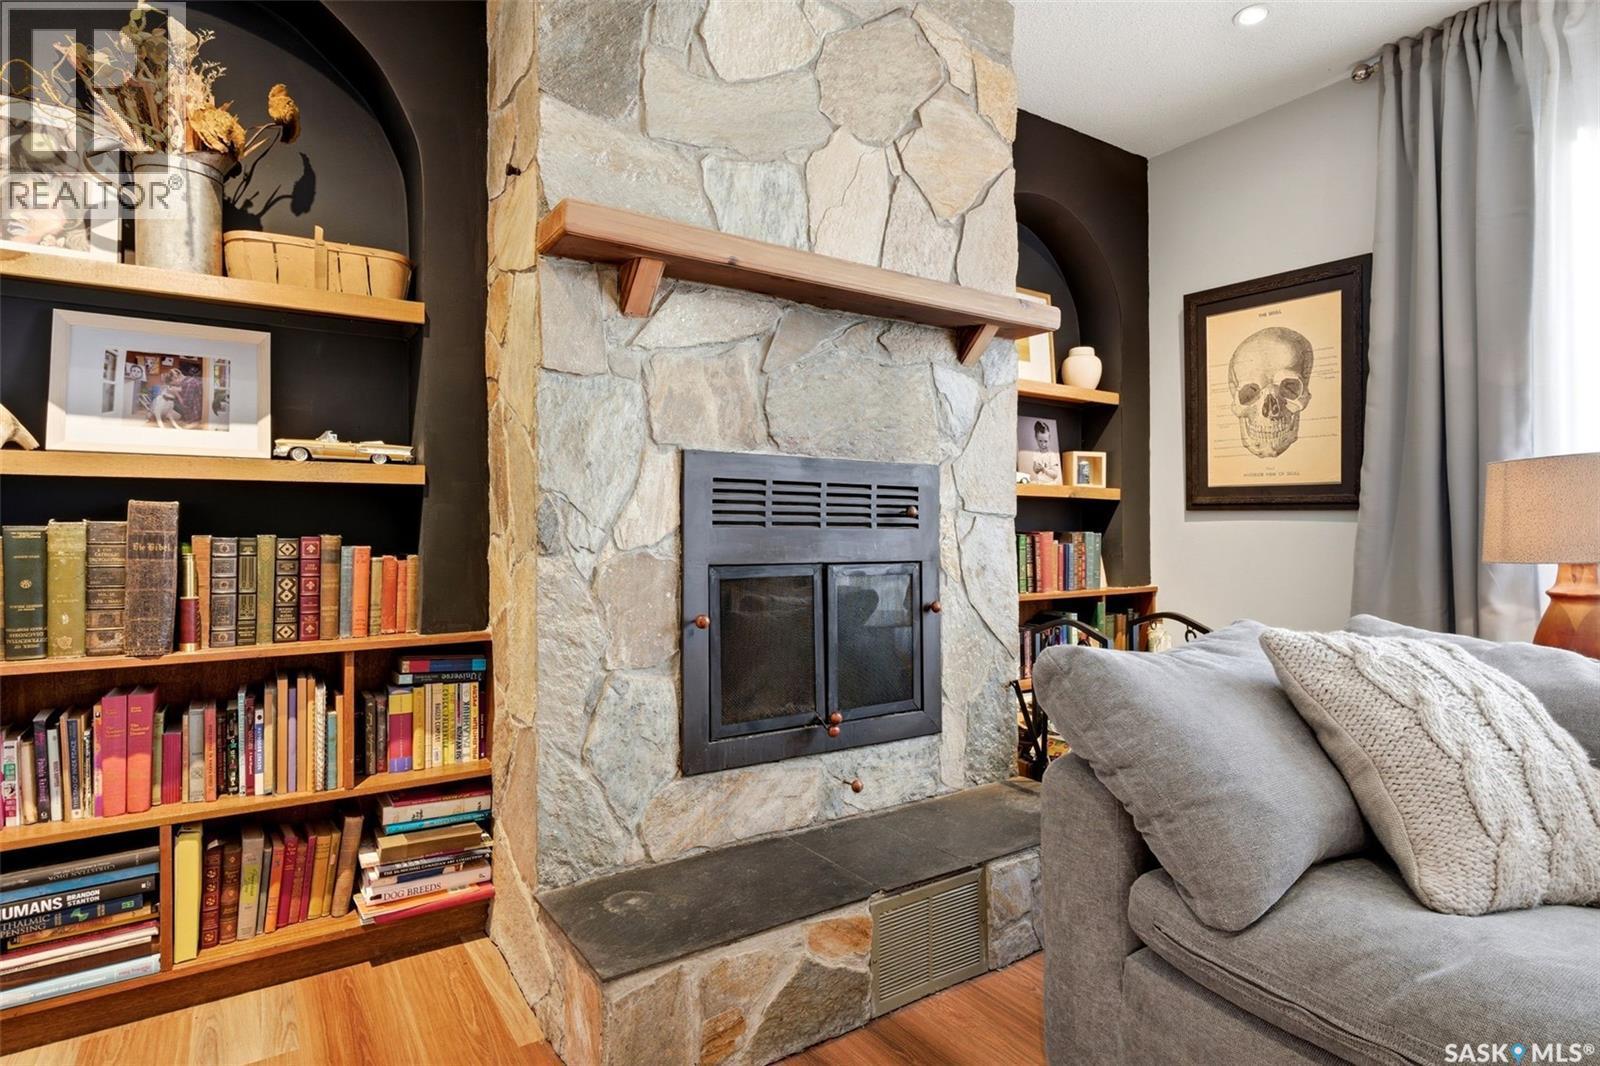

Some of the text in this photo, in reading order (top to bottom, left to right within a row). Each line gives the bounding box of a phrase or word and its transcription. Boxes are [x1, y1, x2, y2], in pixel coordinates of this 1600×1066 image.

[441, 672, 478, 680] Universe
[66, 889, 100, 902] BRANDON
[383, 882, 441, 901] DOG BREEDS
[67, 896, 100, 907] STANTON
[0, 897, 63, 921] UMANS
